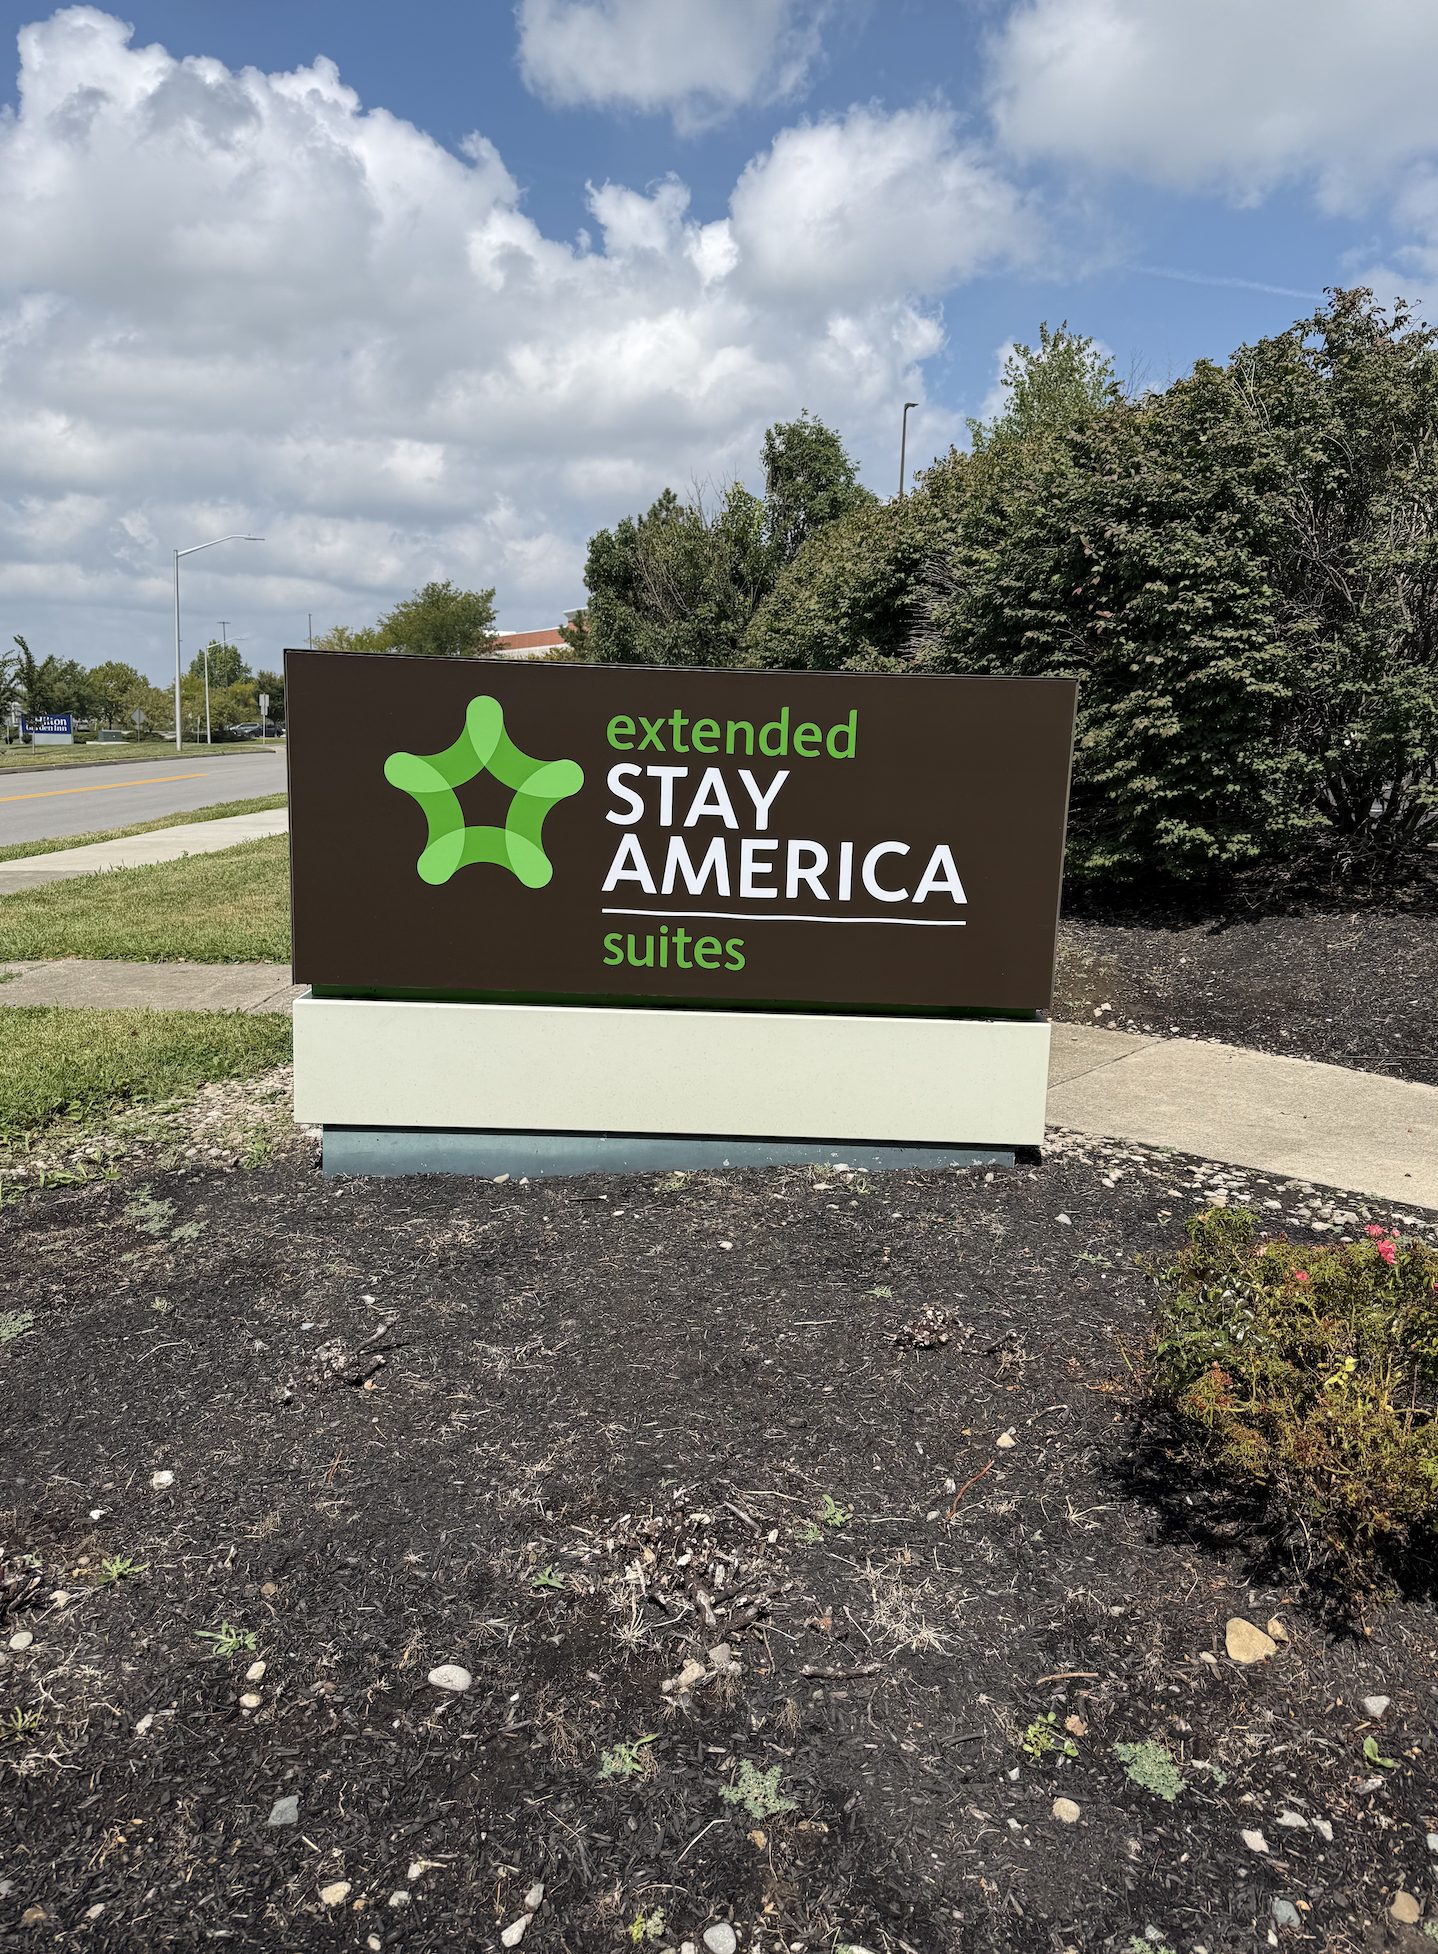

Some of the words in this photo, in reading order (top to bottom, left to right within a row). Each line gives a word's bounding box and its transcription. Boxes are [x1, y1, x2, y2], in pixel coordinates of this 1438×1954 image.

[606, 707, 857, 758] extended
[605, 763, 790, 830] STAY
[601, 833, 967, 904] AMERICA
[602, 925, 745, 971] suites
